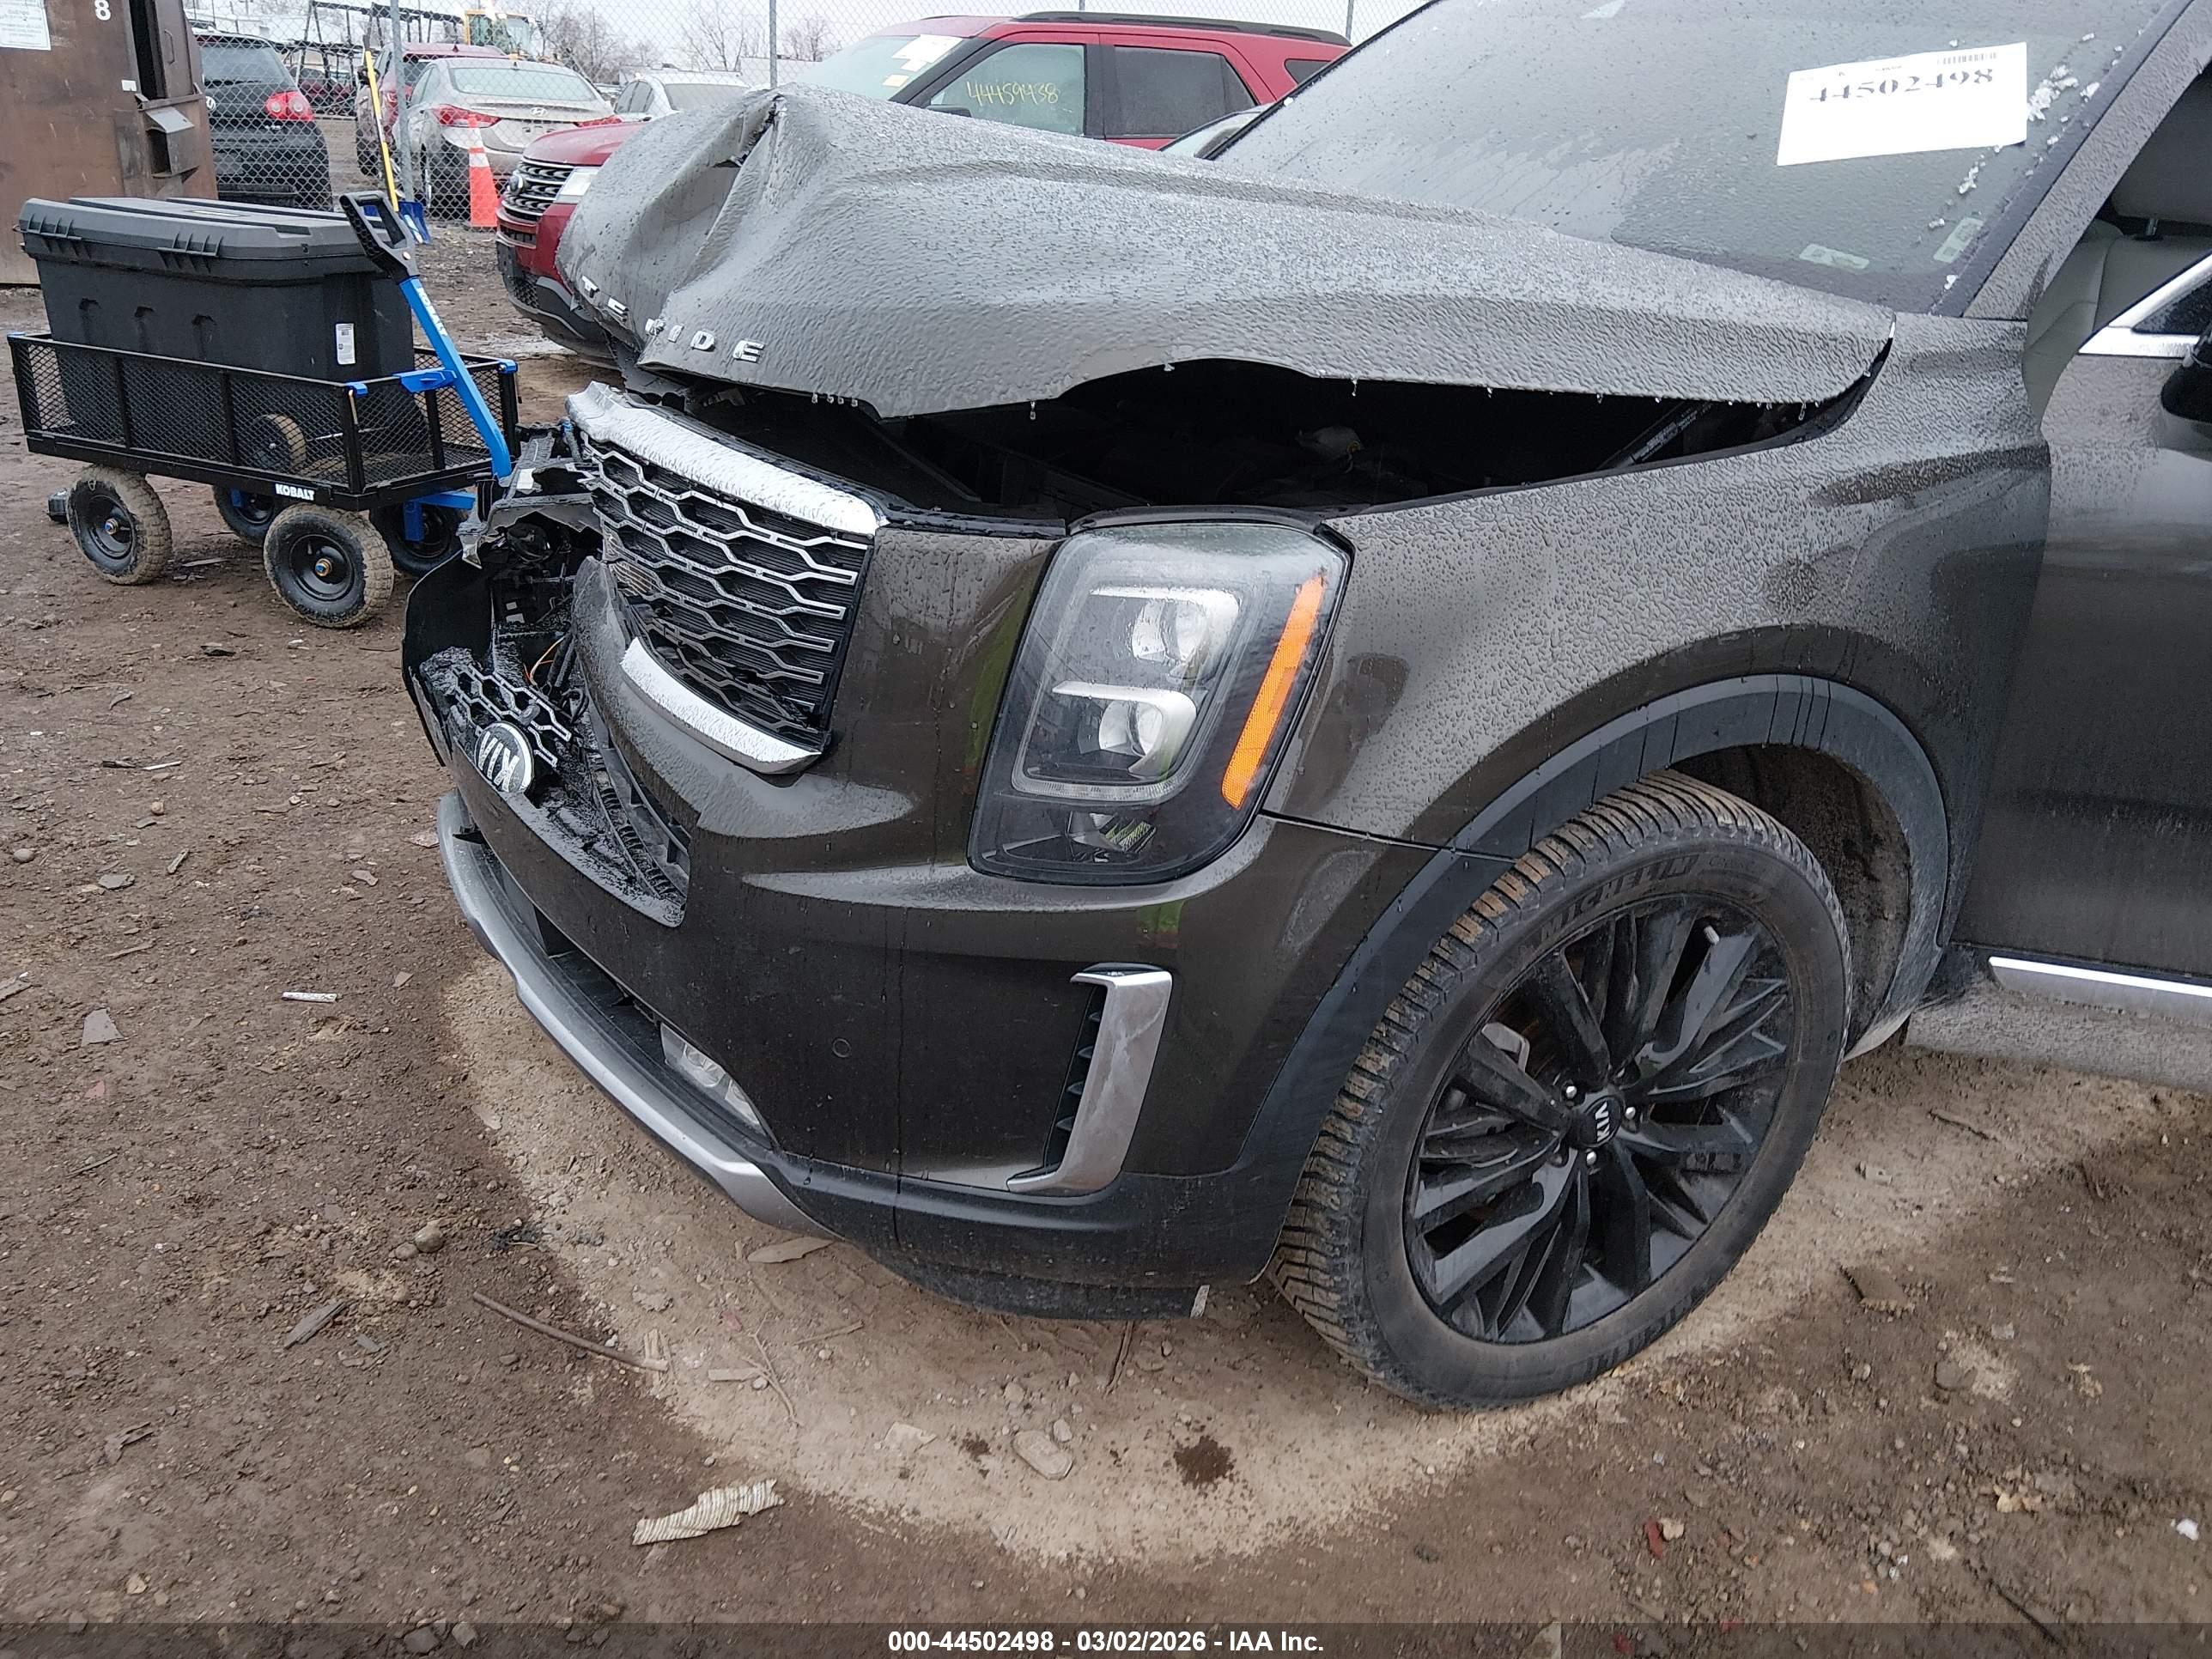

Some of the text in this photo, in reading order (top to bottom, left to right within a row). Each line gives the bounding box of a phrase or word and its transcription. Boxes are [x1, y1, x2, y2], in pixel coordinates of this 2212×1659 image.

[94, 0, 111, 21] 8
[967, 81, 1059, 106] 44459438
[1809, 68, 1993, 102] 44502498
[276, 483, 315, 501] KOBALT
[478, 731, 520, 792] KIA
[1595, 1101, 1610, 1142] KIA
